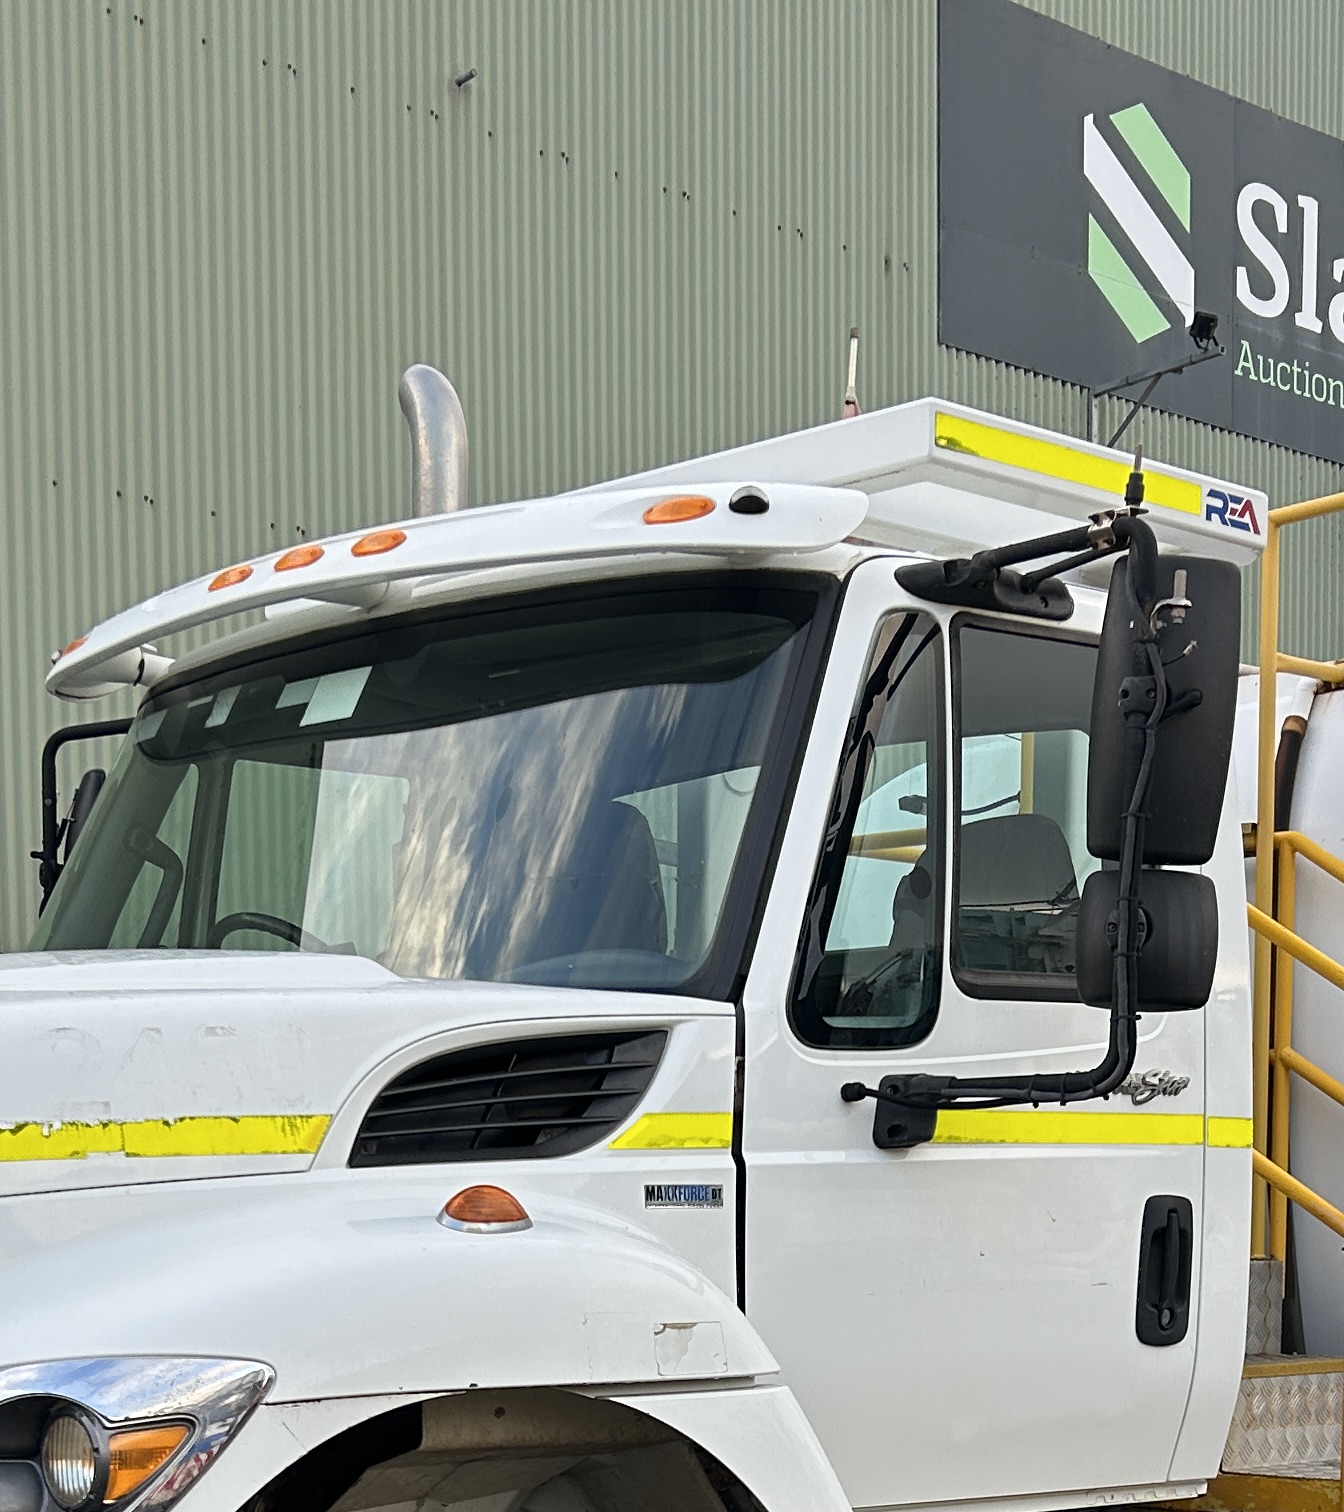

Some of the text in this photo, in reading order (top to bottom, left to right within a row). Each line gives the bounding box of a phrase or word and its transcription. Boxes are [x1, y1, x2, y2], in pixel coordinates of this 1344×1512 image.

[1206, 488, 1261, 535] REA
[645, 1185, 722, 1202] MAXXFORCE DT
